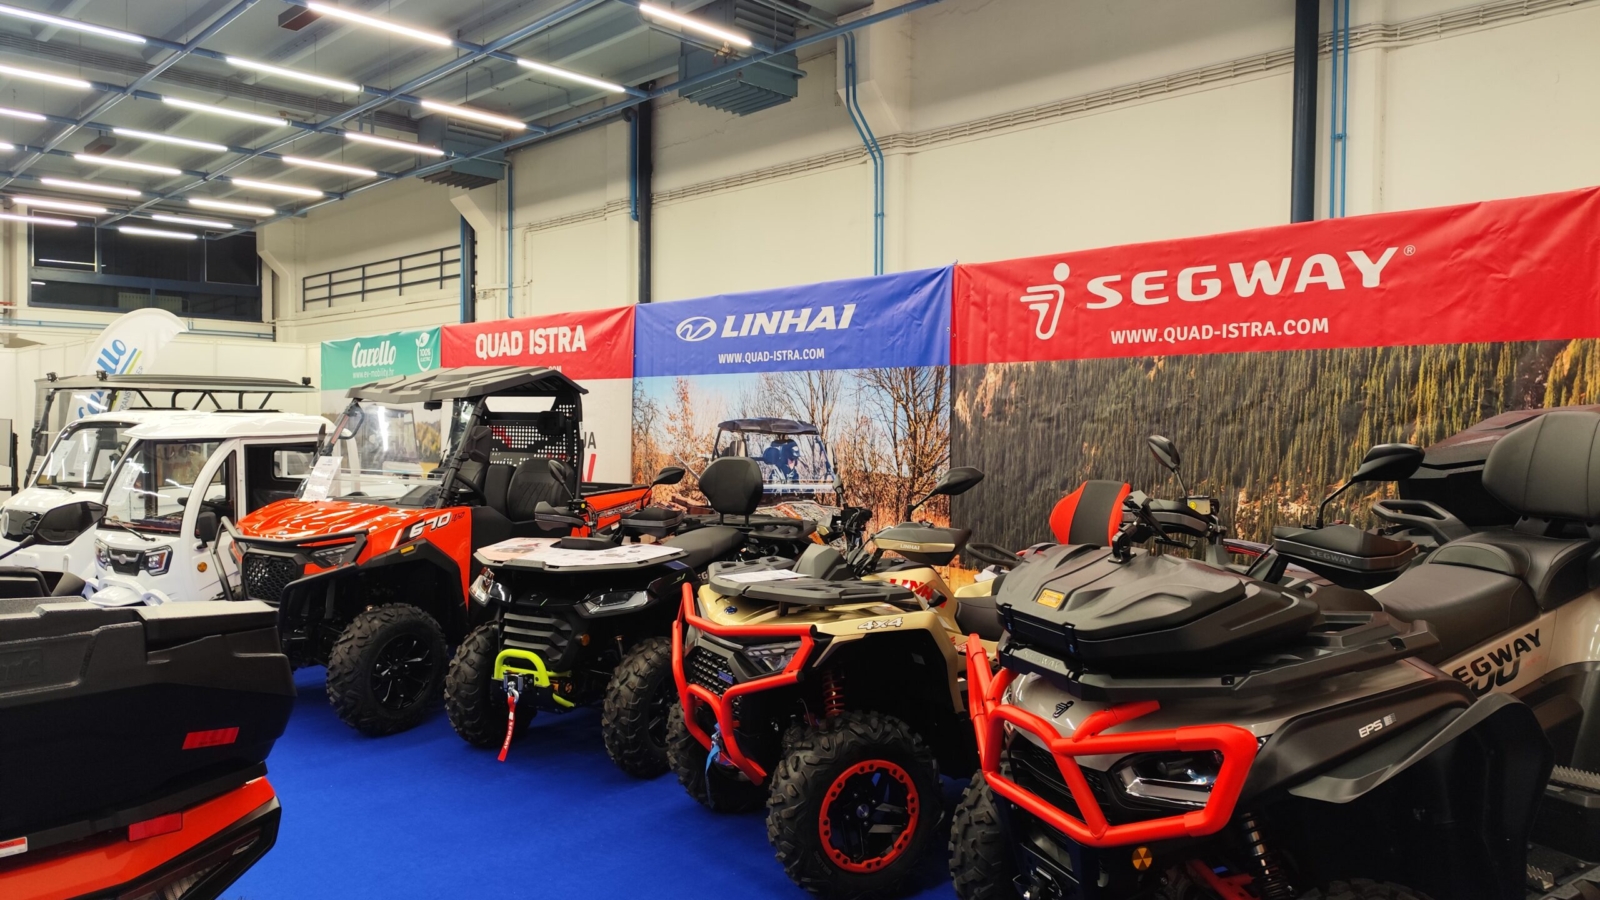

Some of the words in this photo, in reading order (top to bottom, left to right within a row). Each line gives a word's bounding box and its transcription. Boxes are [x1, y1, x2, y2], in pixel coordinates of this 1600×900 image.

[1086, 246, 1399, 310] SEGWAY
[721, 303, 857, 338] LINHAI
[1110, 317, 1329, 345] WWW.QUAD-ISTRA.COM
[352, 340, 396, 368] Carello
[475, 330, 523, 361] QUAD
[529, 324, 587, 355] ISTRA
[718, 347, 825, 364] WWW.QUAD-ISTRA.COM
[352, 368, 395, 378] www.ev-mobility.hr
[409, 512, 452, 539] 670
[1309, 549, 1353, 565] SEGWAY
[1451, 628, 1541, 685] EGWAY
[1358, 719, 1383, 738] EPS
